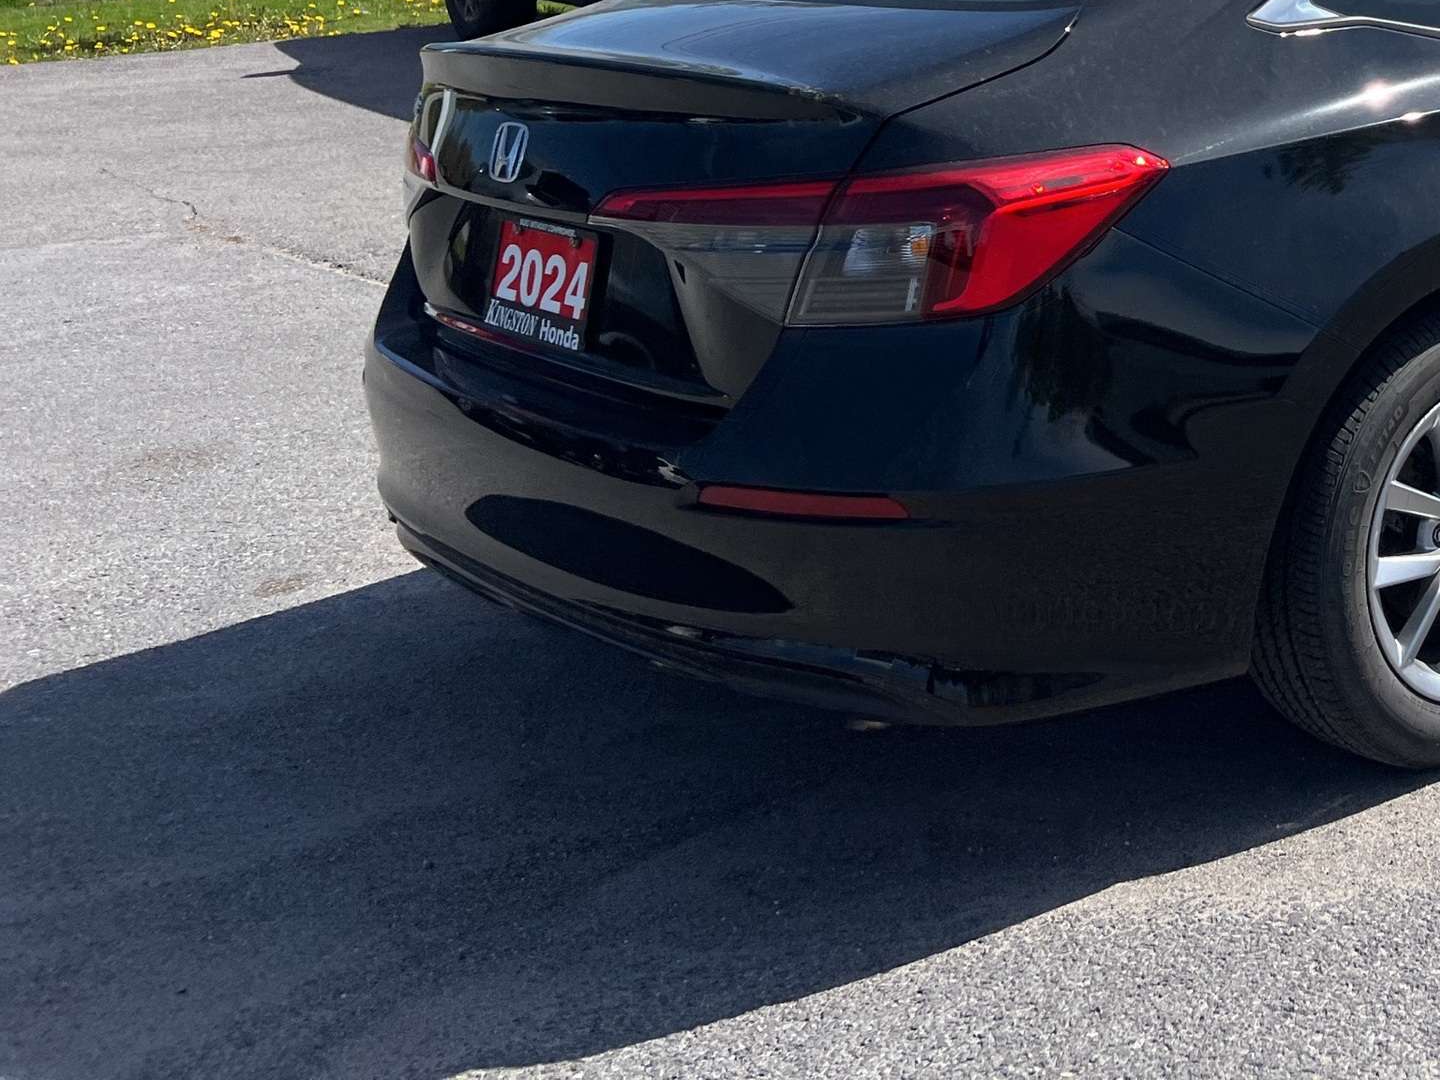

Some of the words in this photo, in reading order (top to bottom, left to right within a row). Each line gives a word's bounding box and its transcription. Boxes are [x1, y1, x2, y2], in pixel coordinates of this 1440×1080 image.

[496, 244, 588, 320] 2024
[484, 299, 539, 336] KINGSTON
[539, 319, 579, 350] Honda
